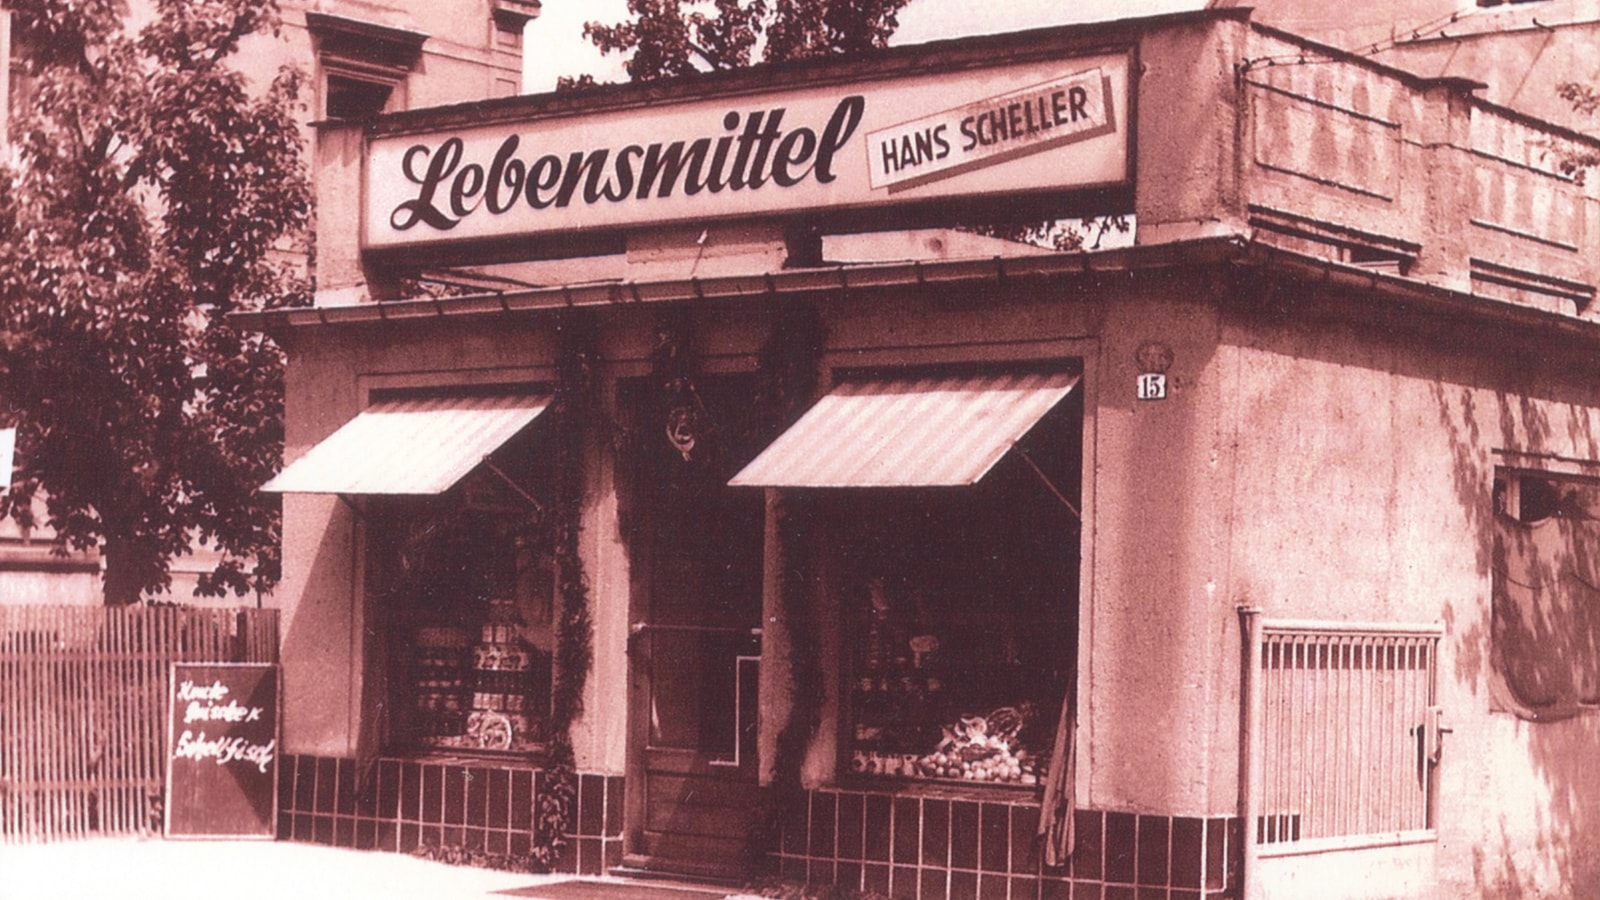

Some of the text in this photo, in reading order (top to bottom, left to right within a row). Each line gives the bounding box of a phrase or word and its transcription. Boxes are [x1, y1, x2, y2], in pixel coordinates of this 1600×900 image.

[390, 95, 865, 231] Lebensmittel
[881, 86, 1088, 174] HANS SCHELLER
[1142, 376, 1161, 397] 15
